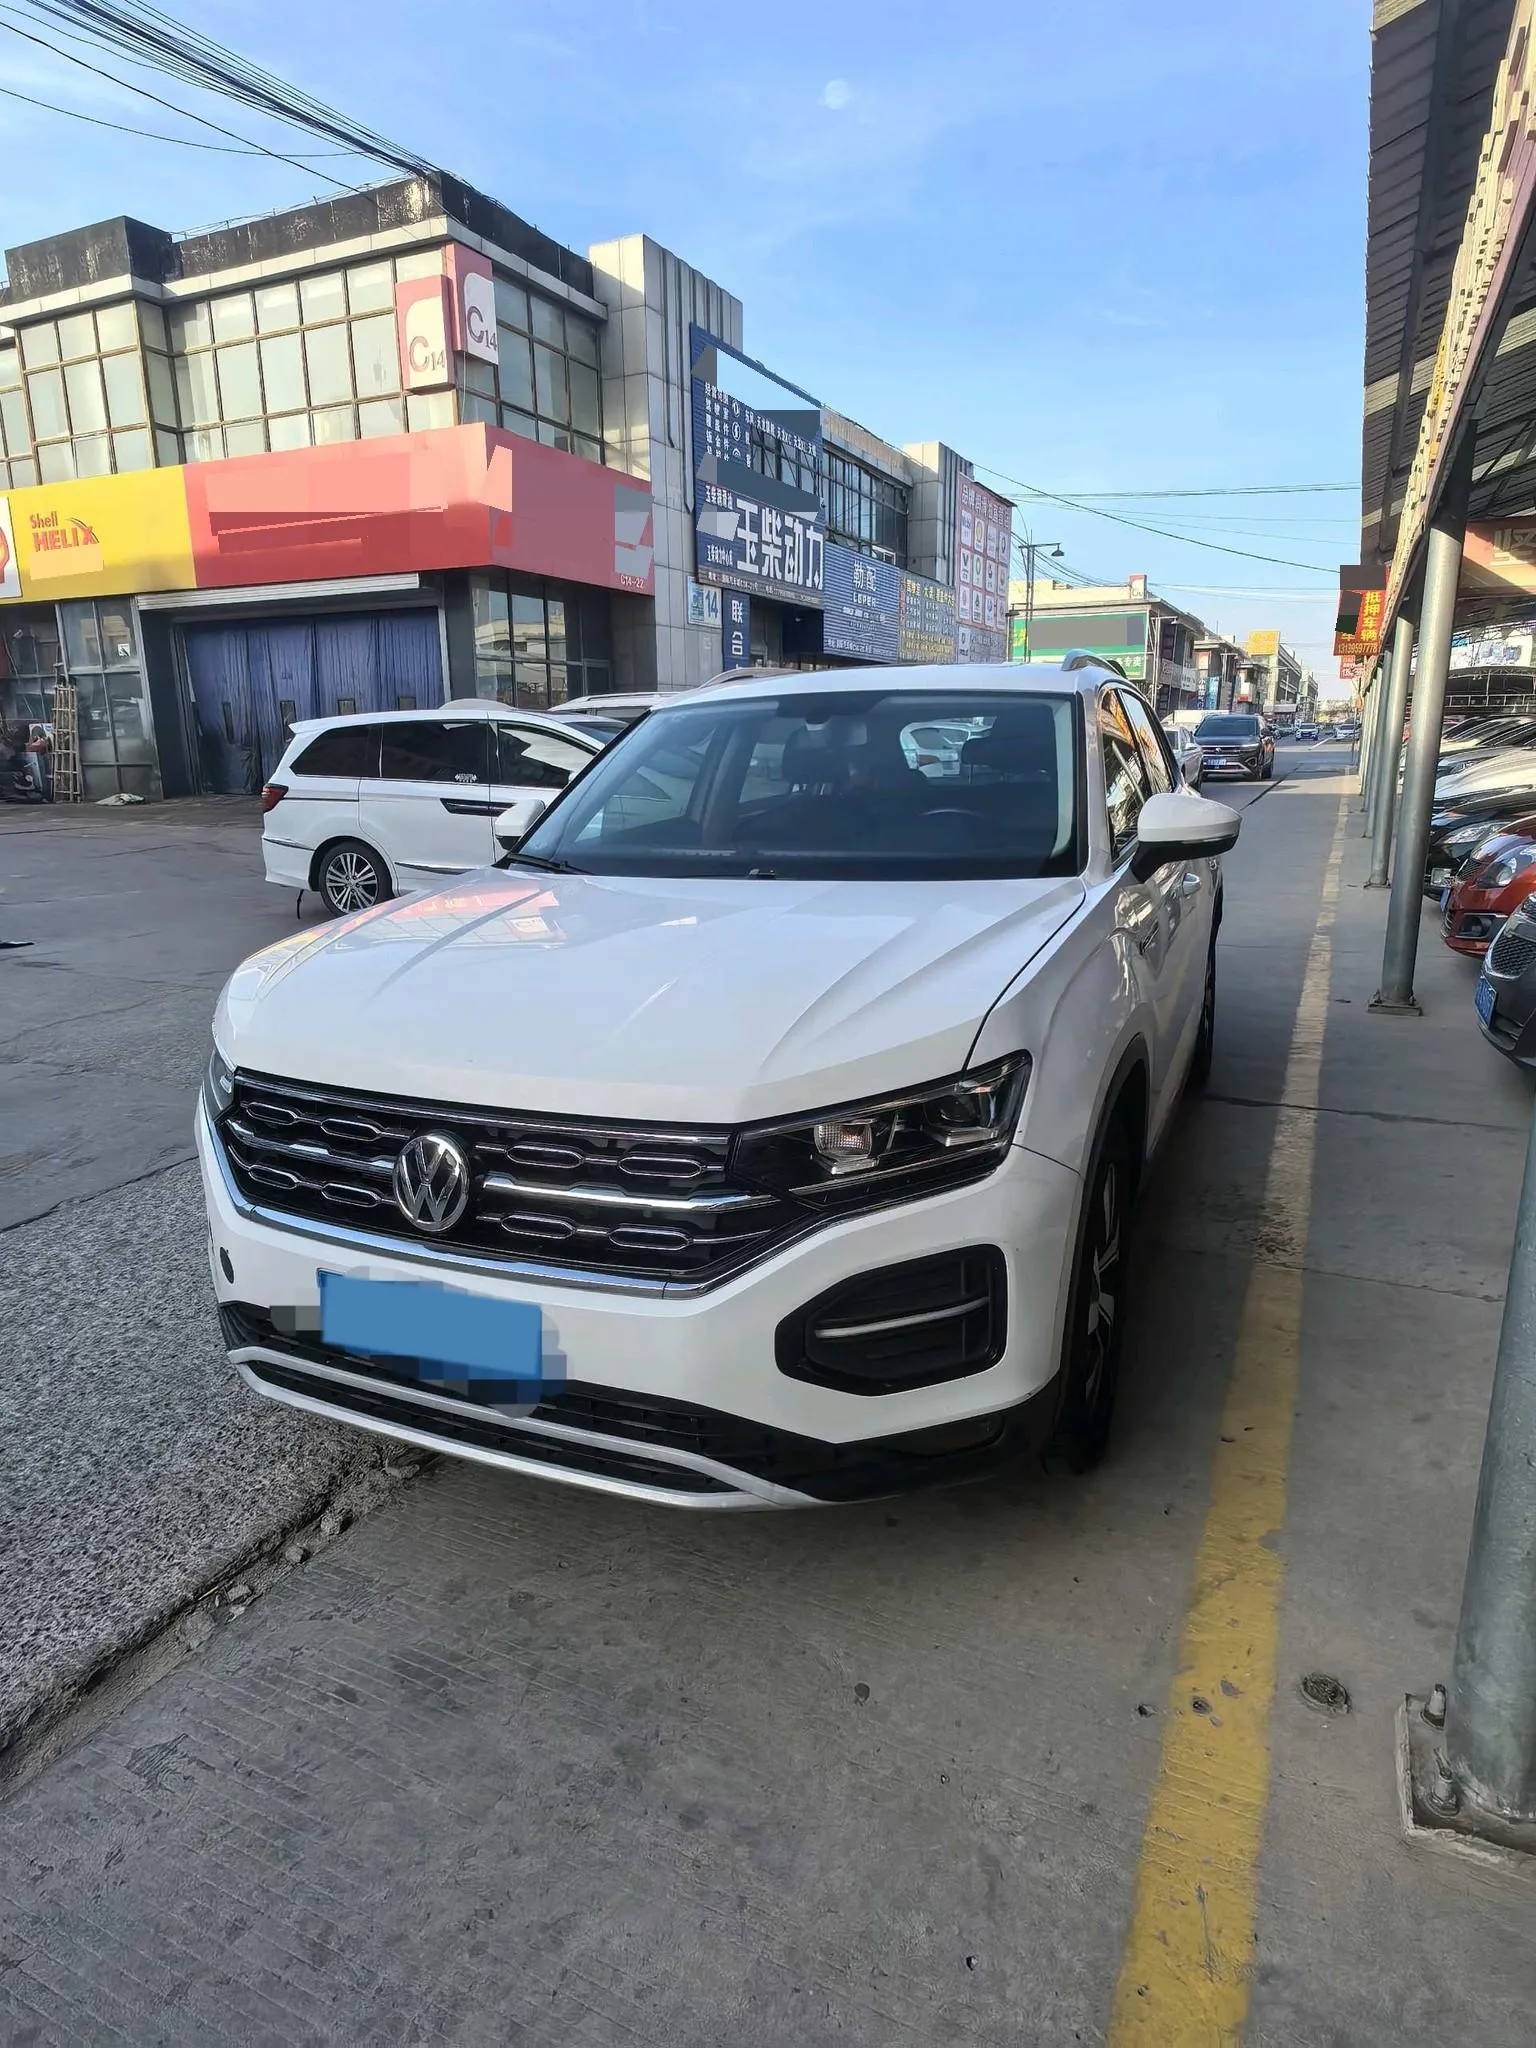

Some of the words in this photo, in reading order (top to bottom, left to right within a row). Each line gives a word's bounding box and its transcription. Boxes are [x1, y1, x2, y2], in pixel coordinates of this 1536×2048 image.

[466, 305, 498, 352] C14
[408, 335, 446, 373] C14
[30, 510, 58, 529] Shell
[32, 525, 99, 553] HELIX
[736, 498, 823, 592] 玉柴动力
[705, 587, 719, 620] 14
[1360, 591, 1381, 641] 抵押车辆
[731, 599, 743, 669] 联合
